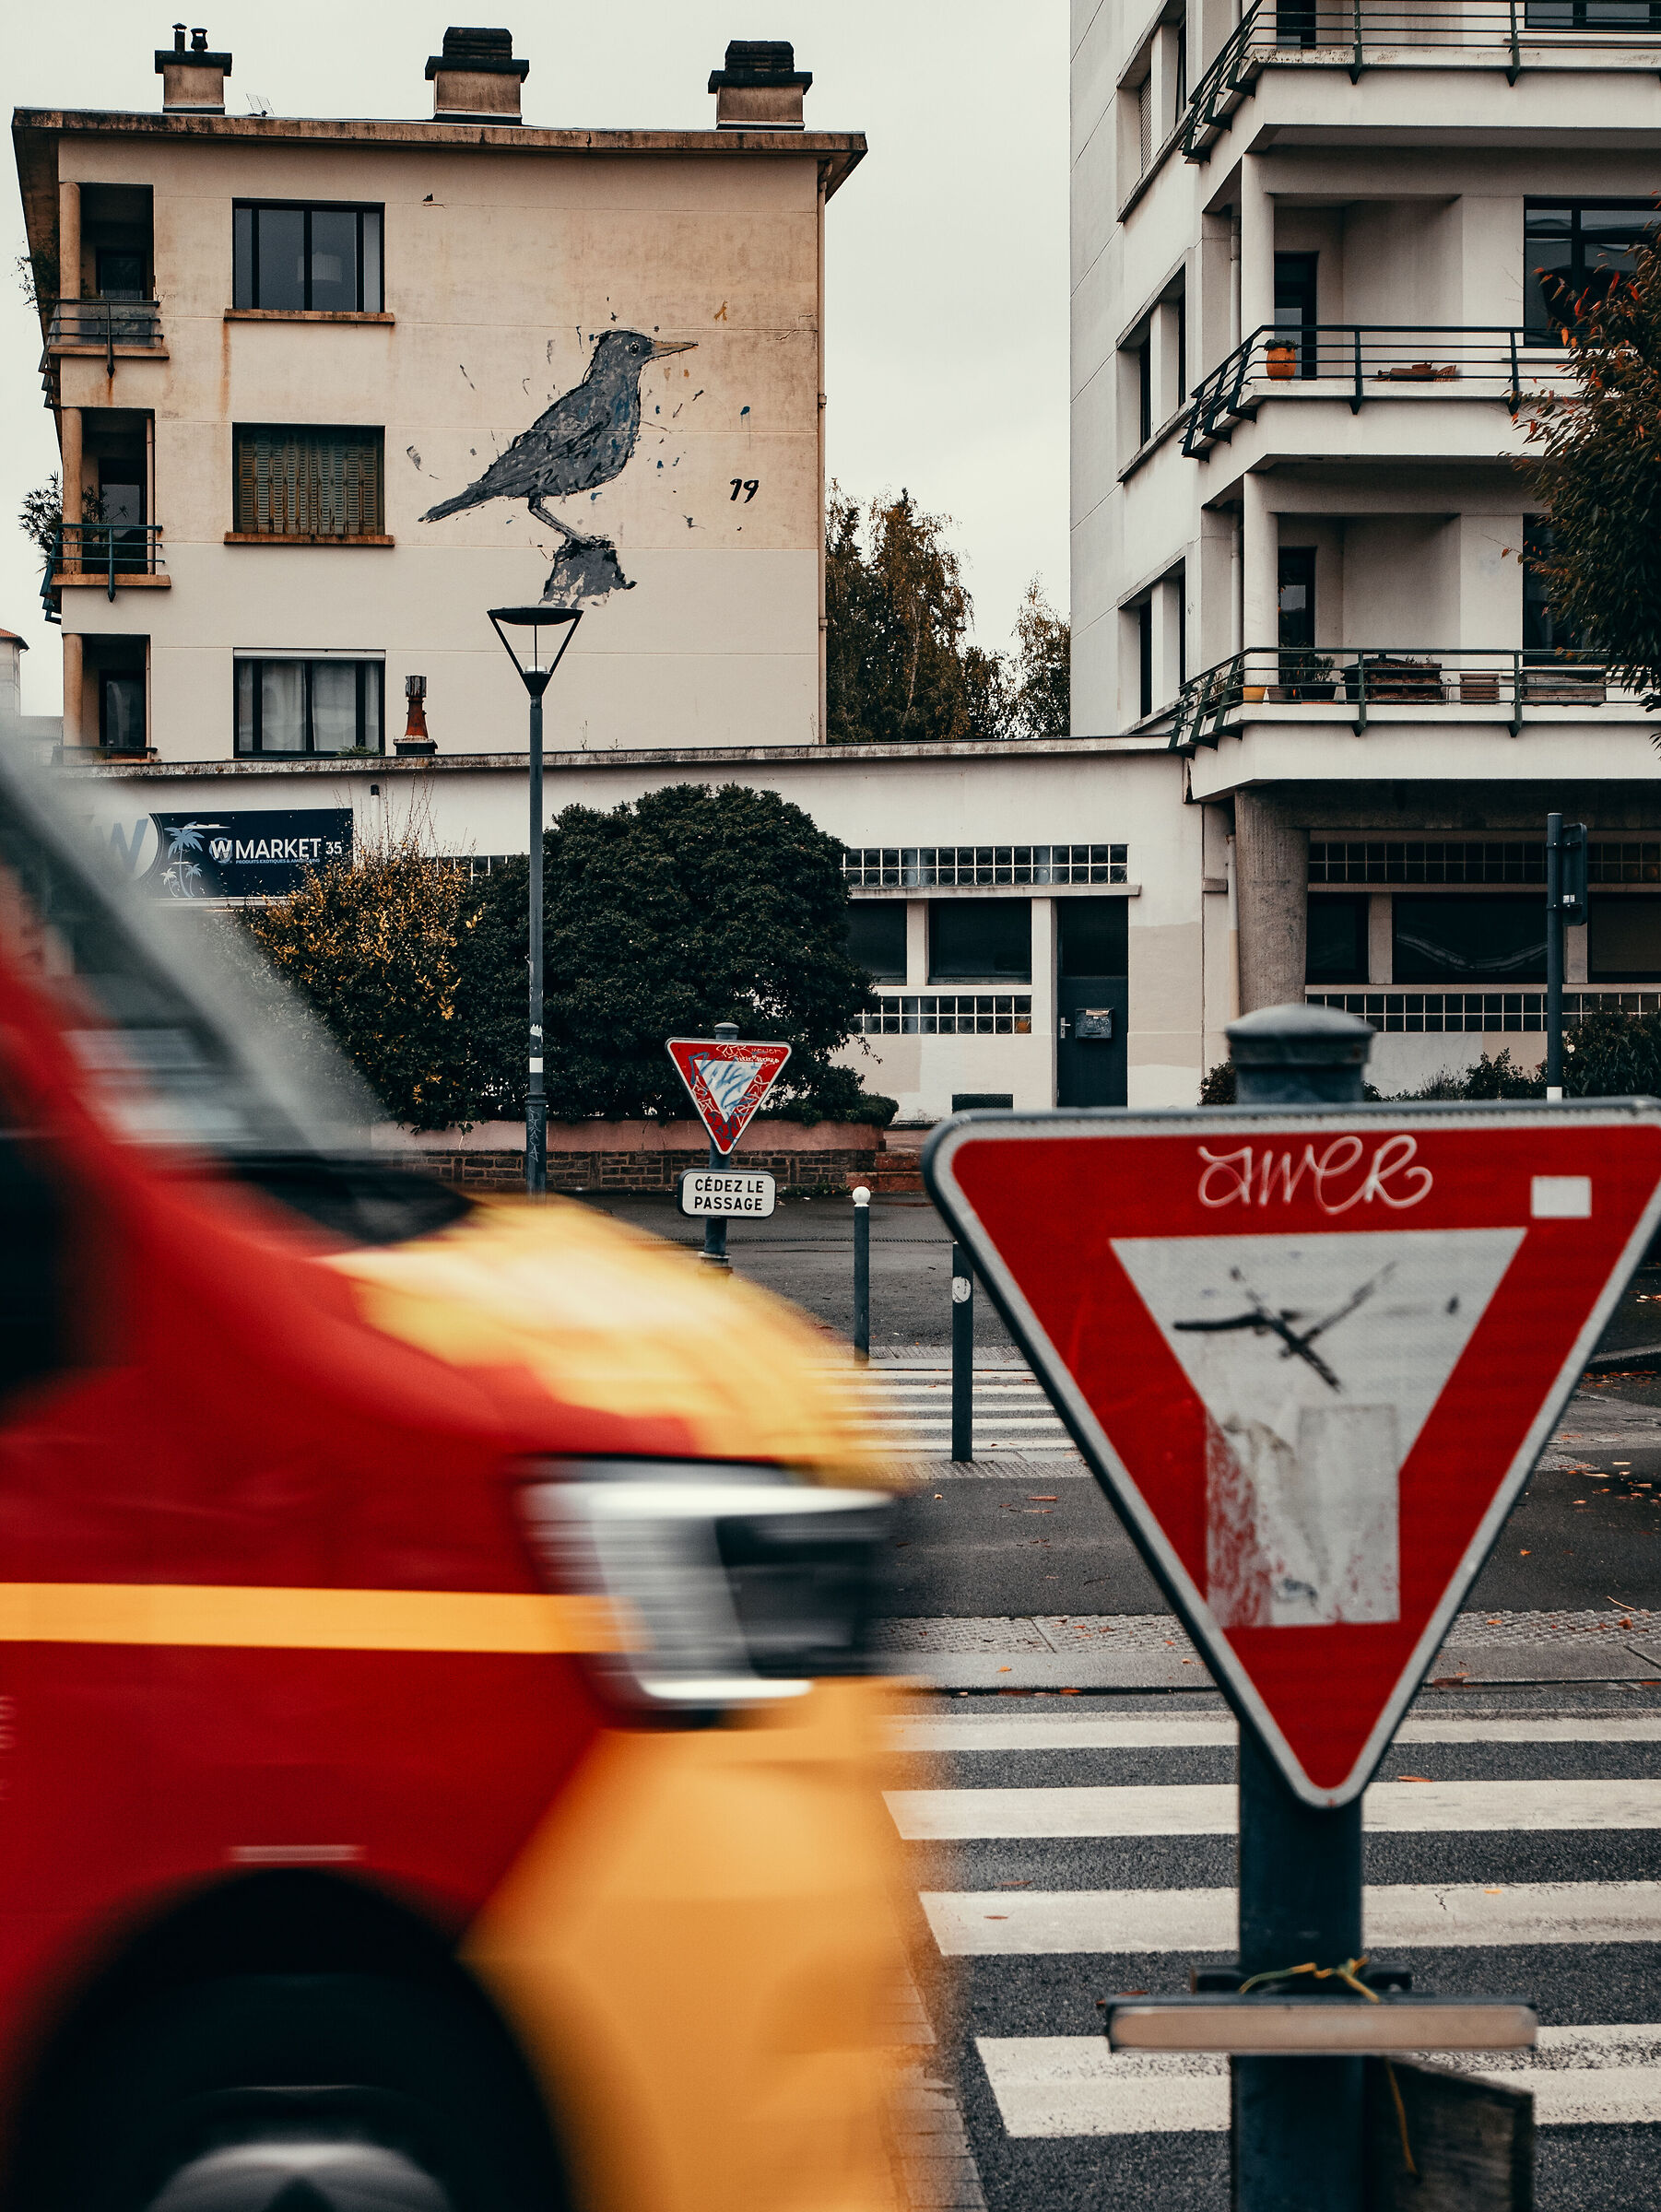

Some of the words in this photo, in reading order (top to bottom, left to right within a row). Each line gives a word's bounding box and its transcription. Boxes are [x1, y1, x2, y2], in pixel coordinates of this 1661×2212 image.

[730, 478, 760, 503] 19
[236, 838, 322, 859] MARKET
[325, 841, 343, 854] 35
[695, 1176, 743, 1192] CÉDEZ
[747, 1180, 764, 1193] LE
[694, 1196, 763, 1210] PASSAGE
